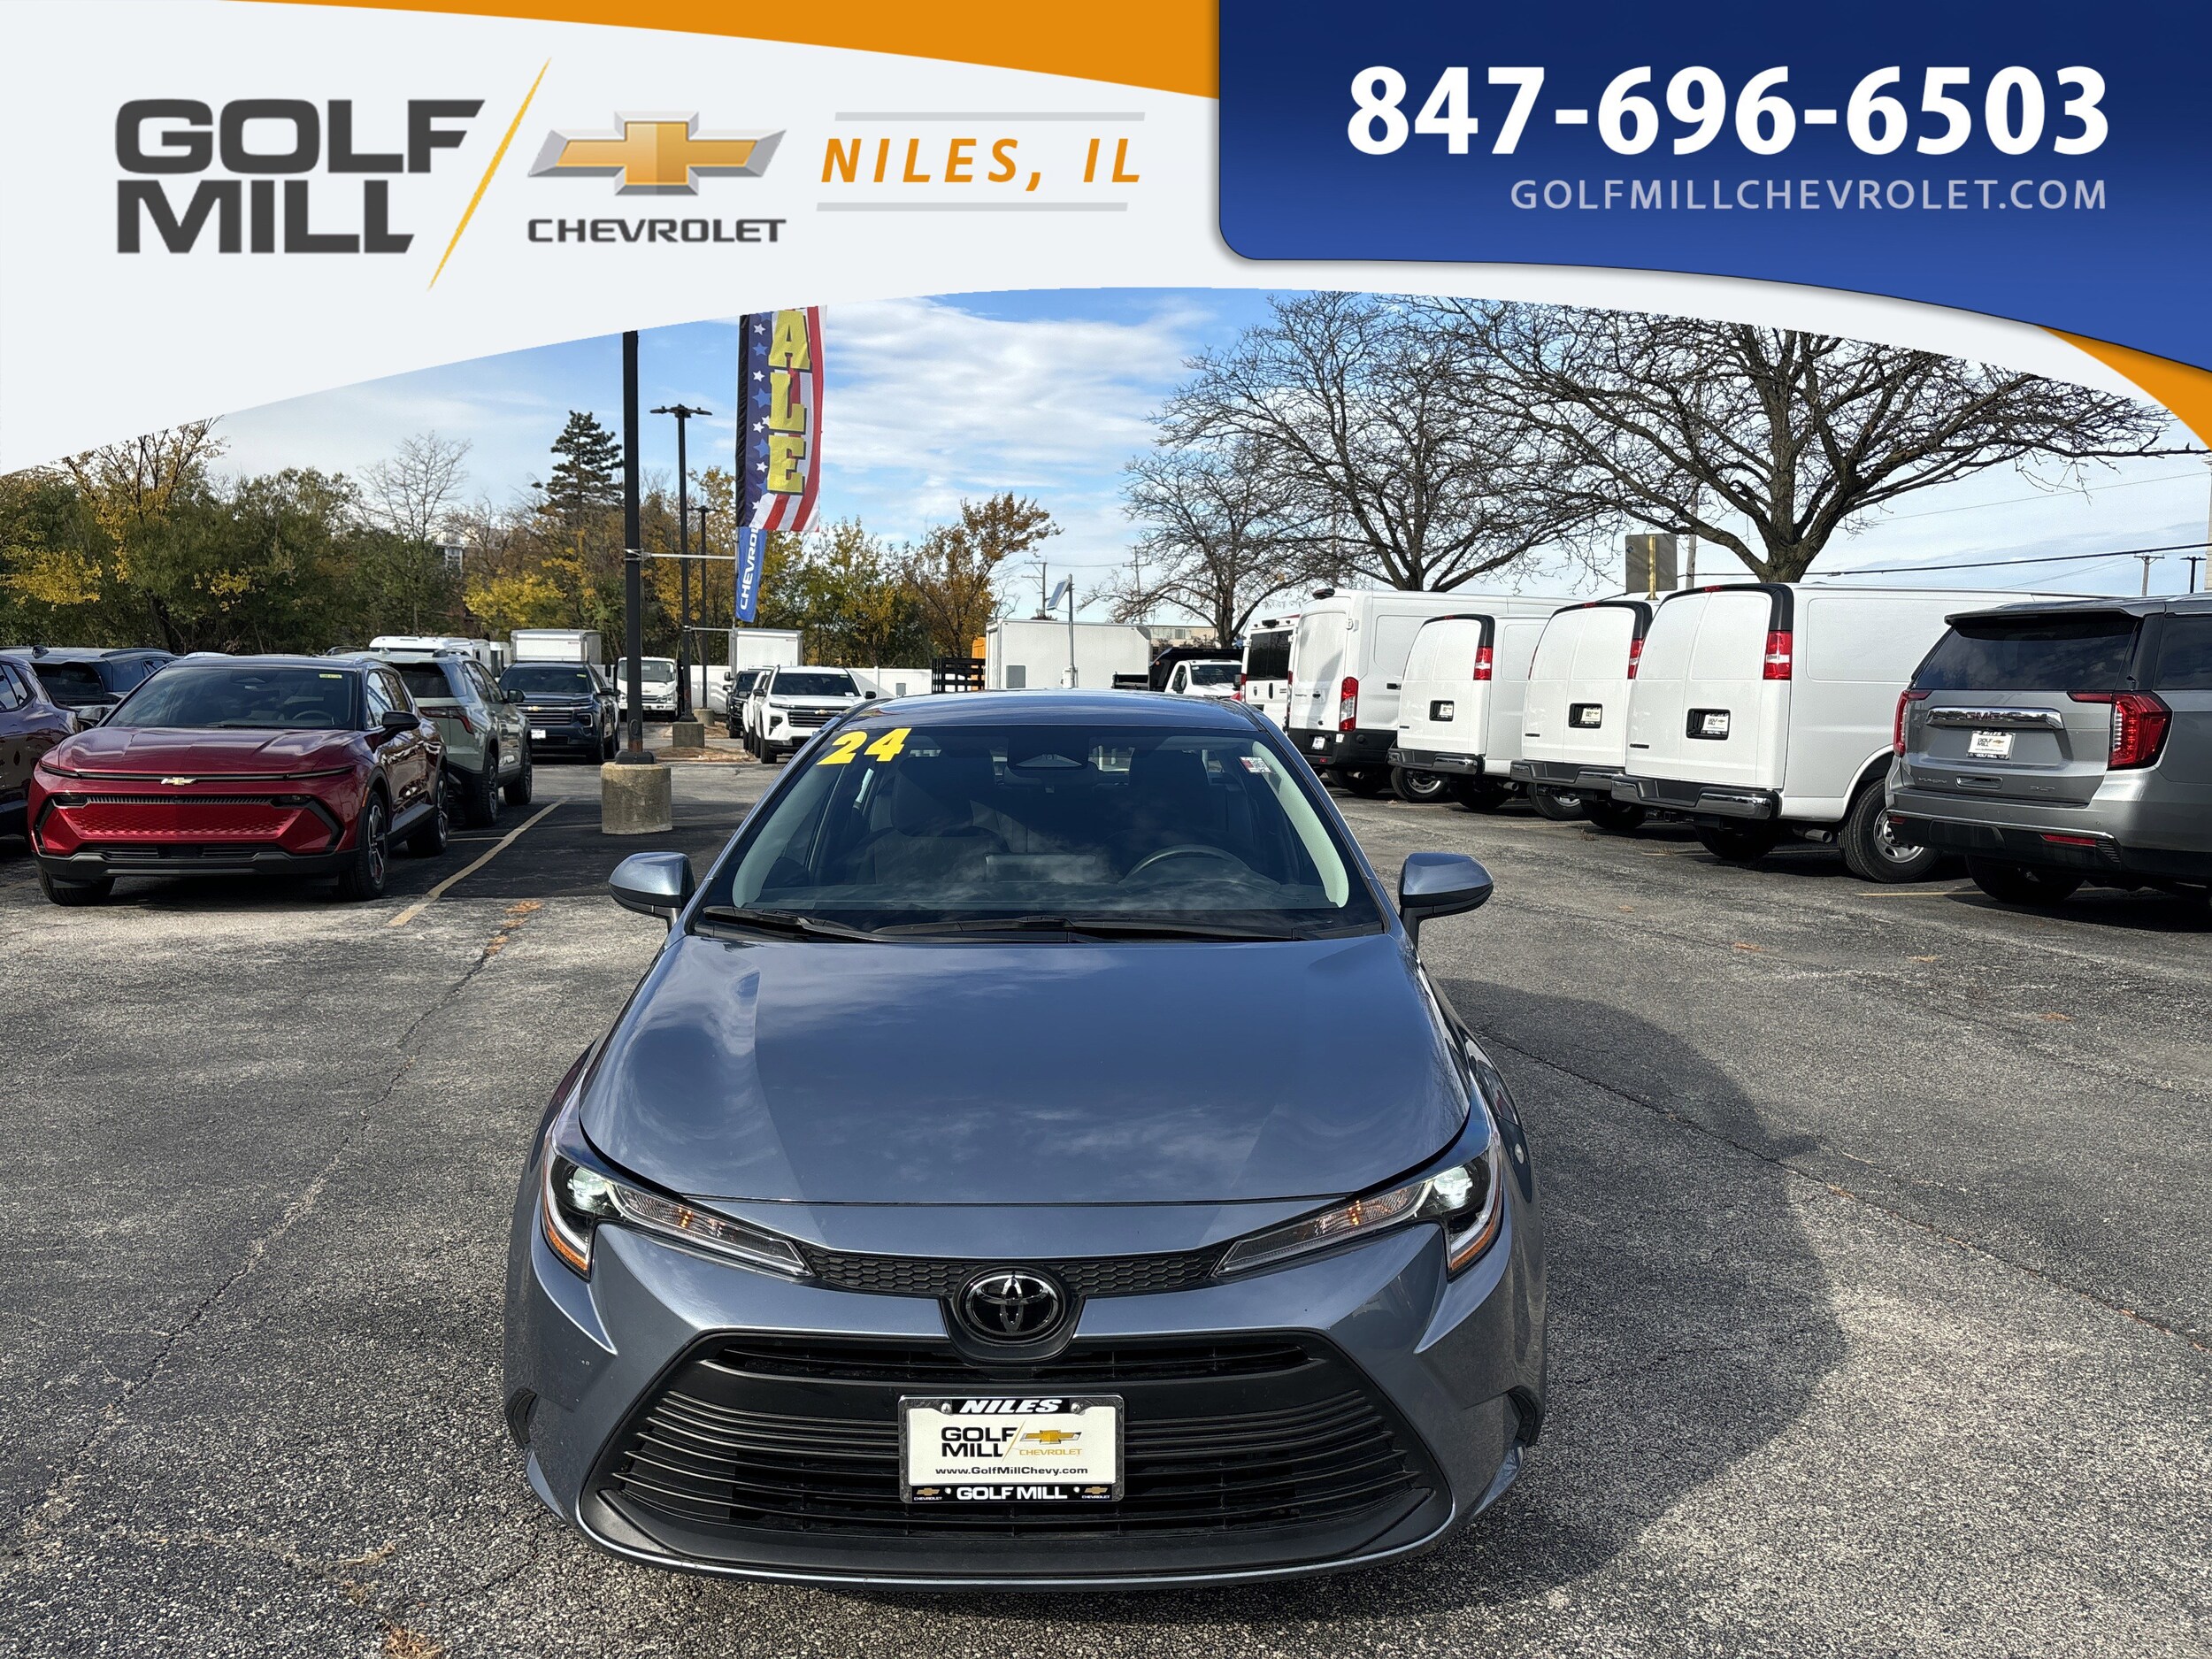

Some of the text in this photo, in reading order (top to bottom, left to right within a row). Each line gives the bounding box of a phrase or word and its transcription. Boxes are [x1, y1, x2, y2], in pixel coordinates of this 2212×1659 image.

[816, 728, 912, 765] 24
[958, 1399, 1063, 1414] NILES
[941, 1426, 1018, 1442] GOLF
[941, 1443, 1004, 1457] MILL
[935, 1466, 1088, 1476] www.GolfMillChevy.com
[956, 1486, 1068, 1500] GOLF MILL
